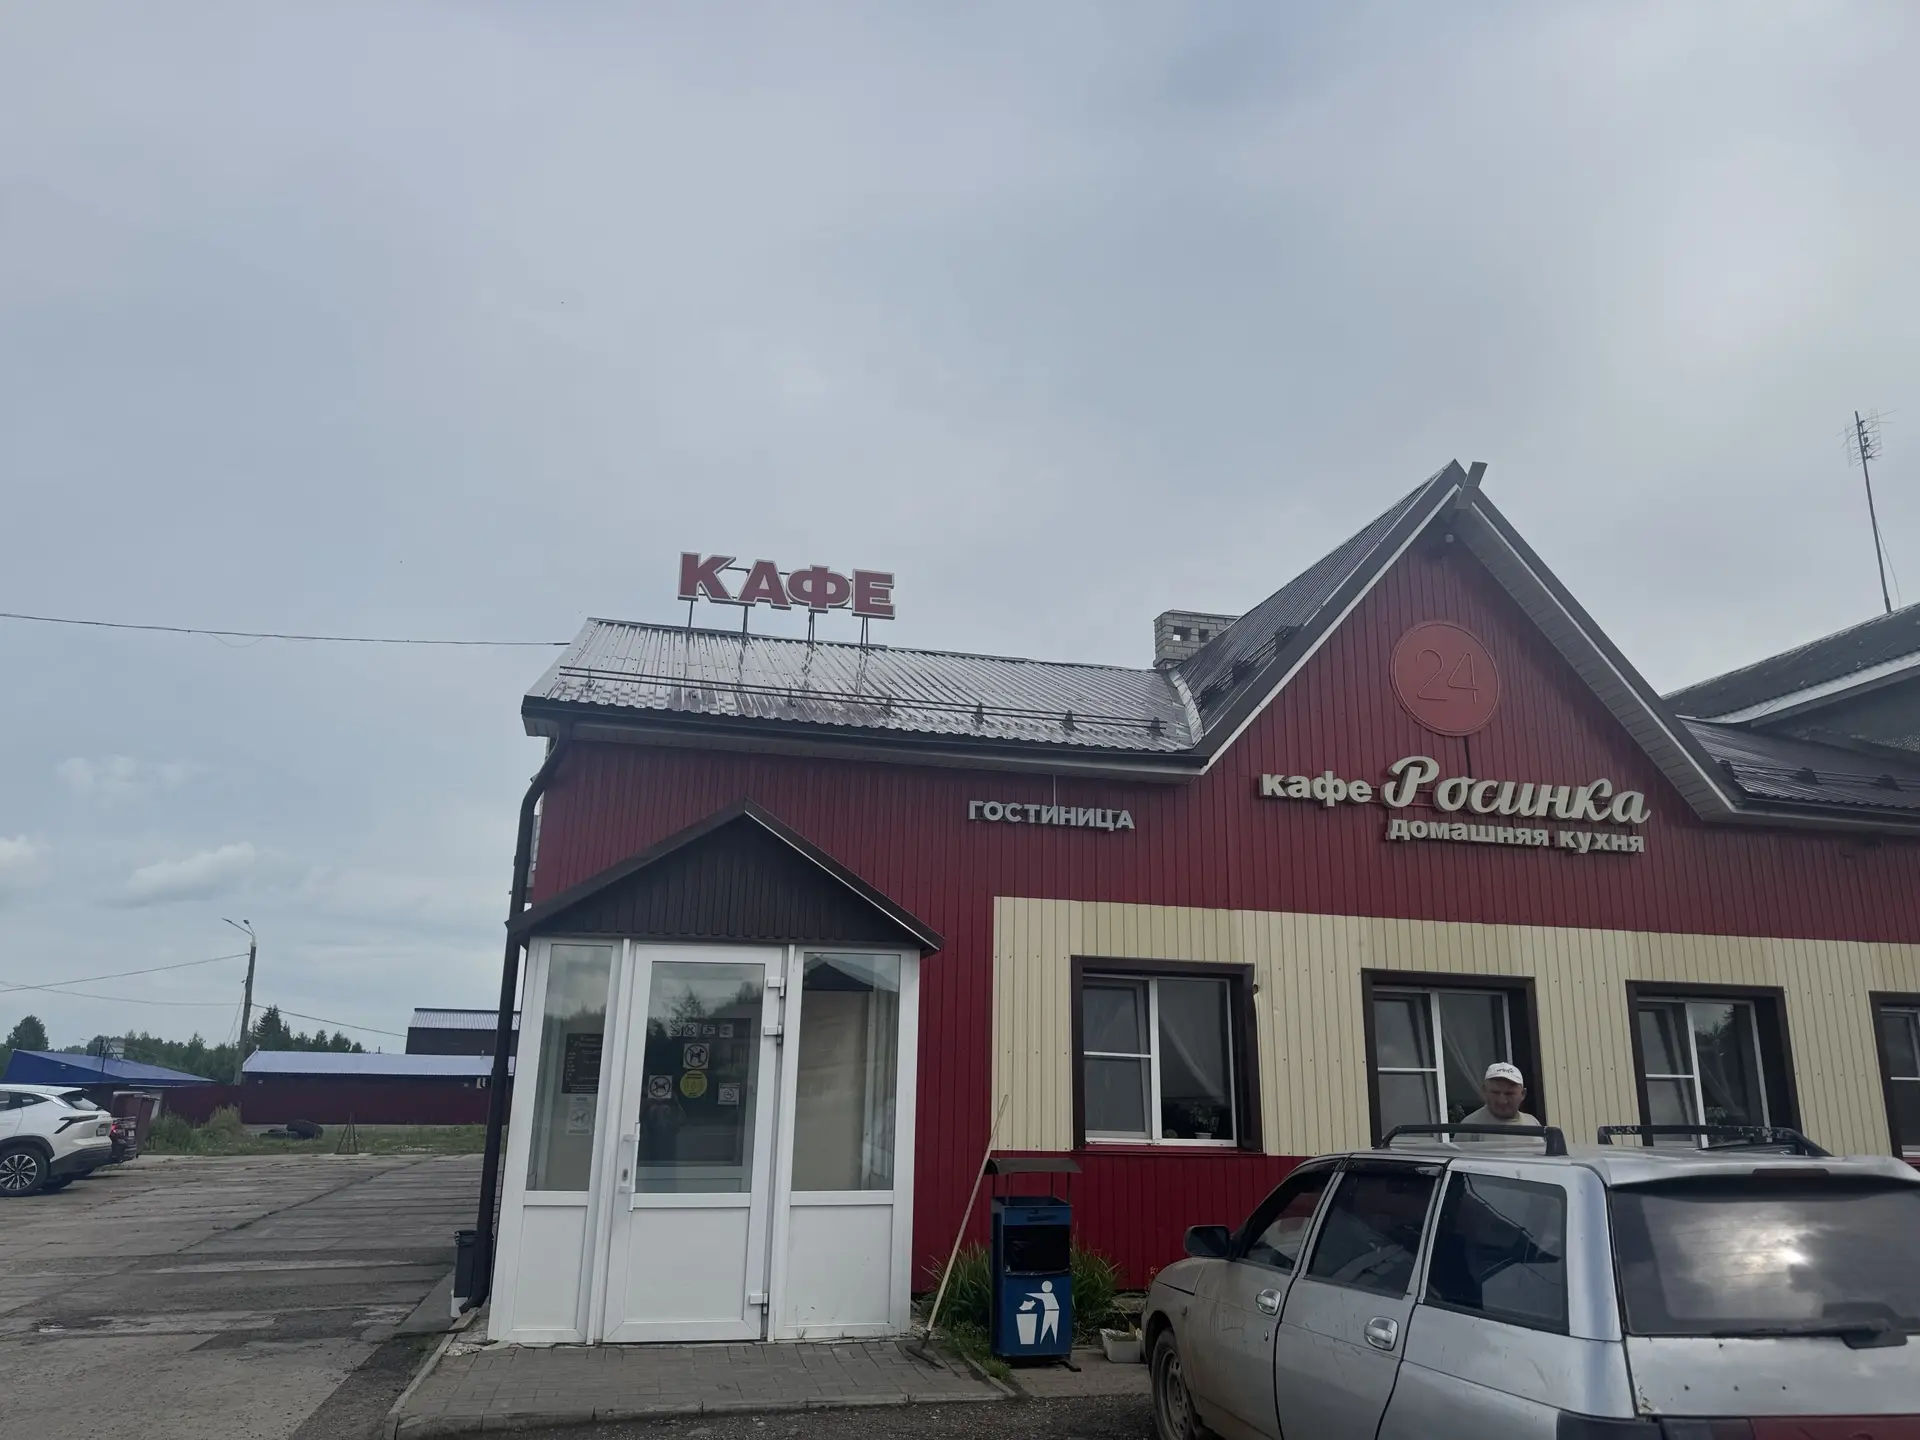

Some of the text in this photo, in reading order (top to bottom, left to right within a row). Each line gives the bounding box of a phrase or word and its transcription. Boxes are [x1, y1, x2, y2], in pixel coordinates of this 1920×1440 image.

[678, 551, 895, 620] КАФЕ
[1416, 648, 1479, 705] 24
[968, 800, 1135, 832] ГОСТИНИЦА
[1260, 755, 1651, 825] кафе Росинка
[1387, 818, 1645, 854] домашняя кухня
